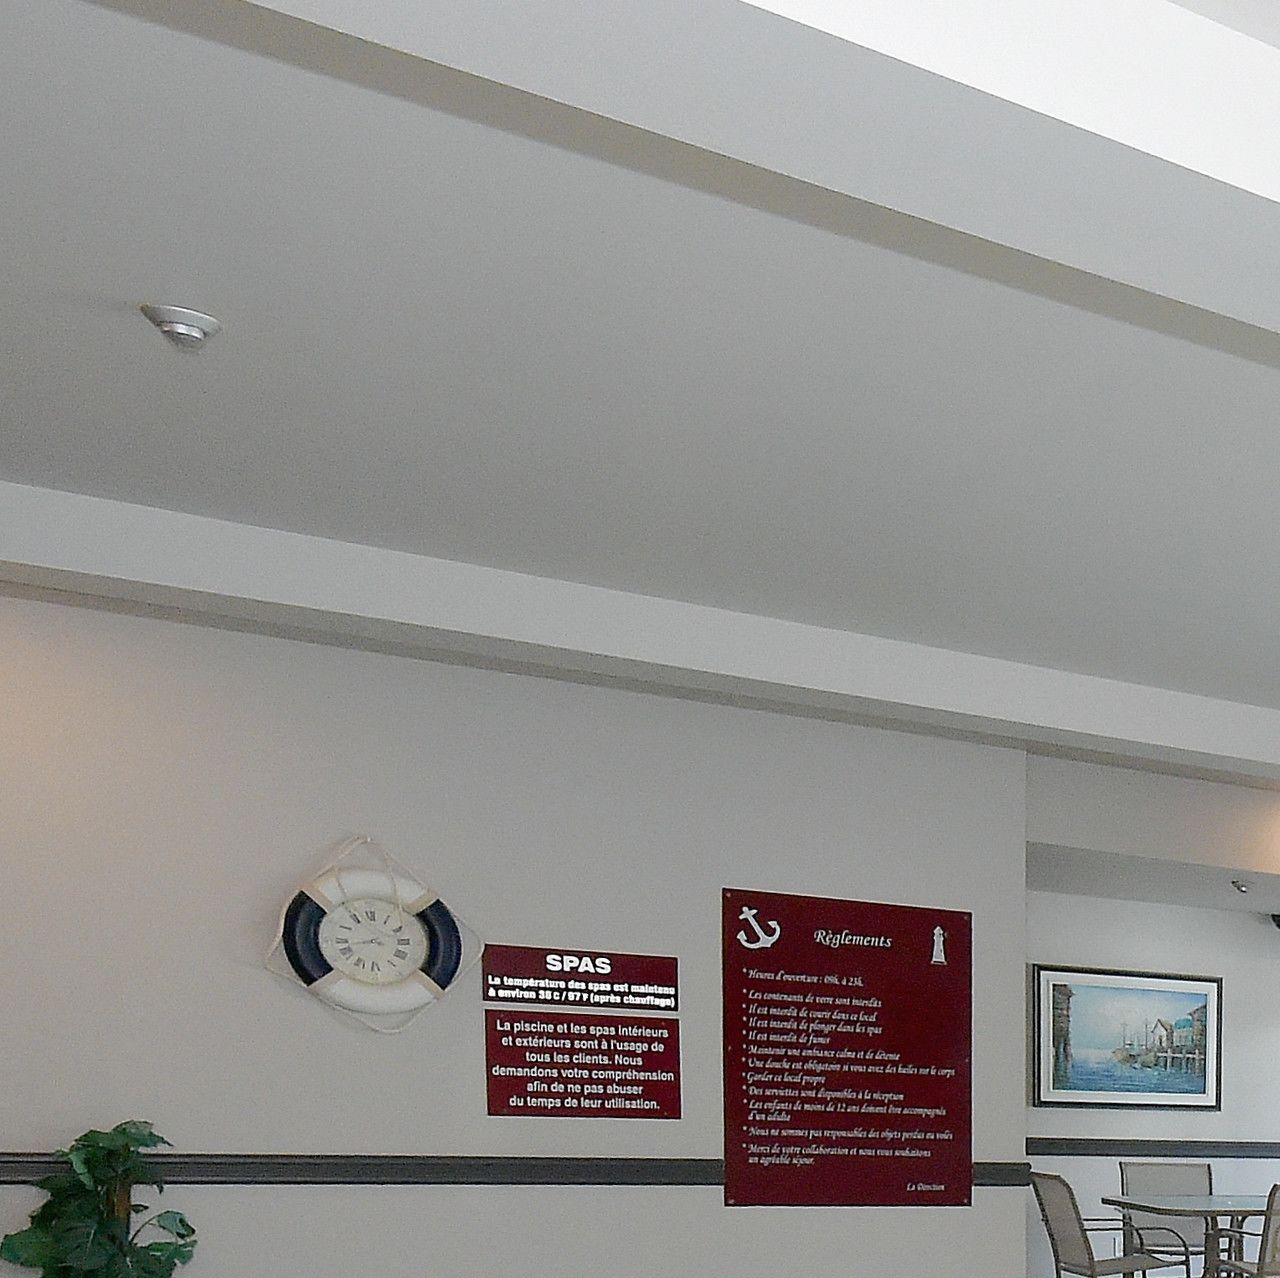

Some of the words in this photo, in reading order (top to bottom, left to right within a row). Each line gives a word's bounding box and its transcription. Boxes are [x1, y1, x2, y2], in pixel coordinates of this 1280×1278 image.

[814, 929, 893, 948] Règlements
[545, 954, 612, 975] SPAS
[488, 974, 501, 985] La
[503, 976, 566, 988] température
[567, 979, 586, 989] des
[588, 982, 612, 992] spas
[613, 983, 629, 992] est
[498, 988, 536, 999] environ
[590, 992, 622, 1004] (après
[623, 994, 676, 1008] chauffage)
[496, 1019, 511, 1031] La
[513, 1020, 554, 1034] piscine
[556, 1023, 568, 1033] et
[570, 1022, 587, 1034] les
[589, 1025, 616, 1037] spas
[618, 1025, 669, 1038] intérieurs
[501, 1035, 513, 1046] et
[515, 1036, 571, 1048] extérieurs
[573, 1039, 599, 1049] sont
[601, 1038, 608, 1050] à
[610, 1039, 649, 1053] l'usage
[651, 1041, 665, 1052] de
[525, 1051, 551, 1062] tous
[553, 1051, 570, 1063] les
[572, 1052, 613, 1064] clients.
[614, 1054, 643, 1065] Nous
[492, 1064, 559, 1077] demandons
[560, 1068, 589, 1079] votre
[591, 1068, 675, 1082] compréhension
[527, 1081, 548, 1092] afin
[550, 1081, 565, 1093] de
[567, 1084, 582, 1093] ne
[583, 1084, 605, 1096] pas
[606, 1083, 644, 1095] abuser
[509, 1095, 524, 1107] du
[526, 1096, 561, 1110] temps
[564, 1097, 579, 1108] de
[580, 1097, 603, 1109] leur
[604, 1098, 661, 1110] utilisation.
